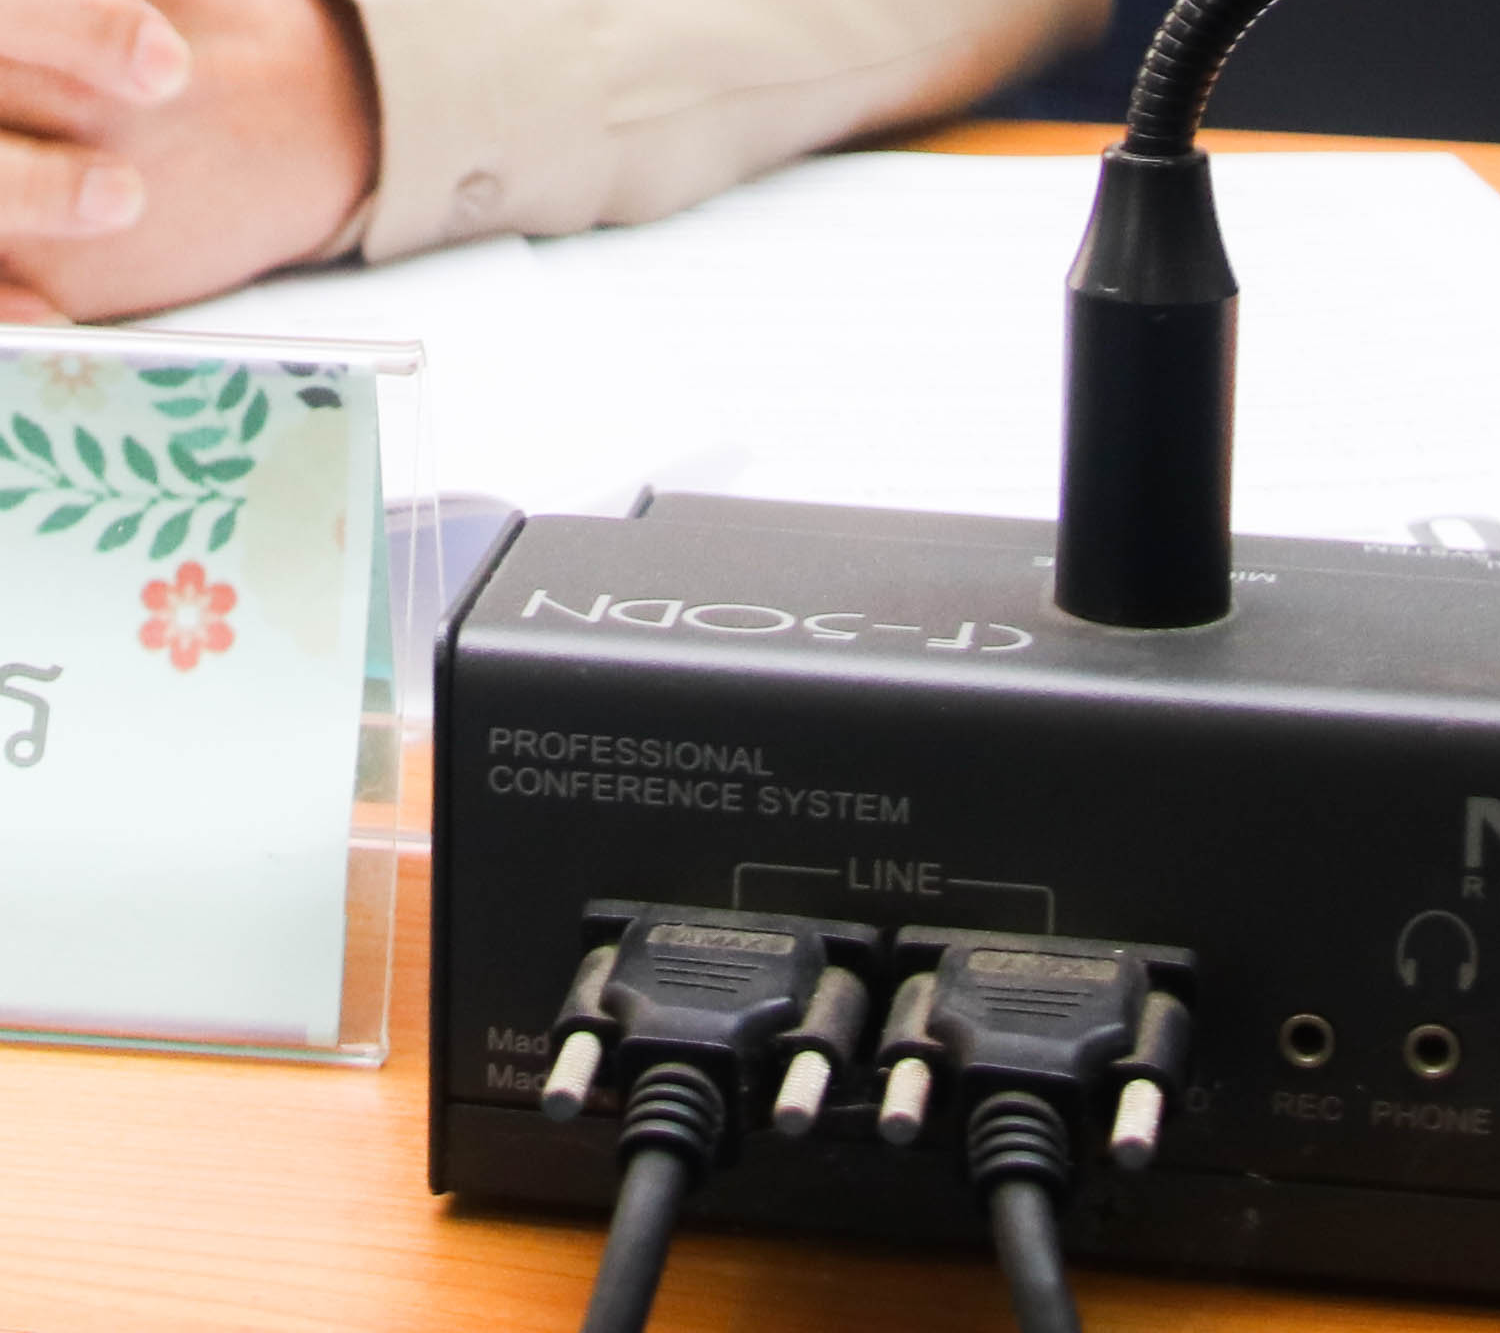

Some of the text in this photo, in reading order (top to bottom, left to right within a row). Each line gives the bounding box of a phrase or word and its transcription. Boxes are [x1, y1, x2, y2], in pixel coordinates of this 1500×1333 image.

[488, 726, 774, 776] PROFESSIONAL
[488, 764, 911, 825] CONFERENCE SYSTEM
[847, 856, 945, 896] LINE
[486, 1025, 551, 1055] Mad
[1271, 1091, 1345, 1122] REC
[1370, 1099, 1494, 1135] PHONE
